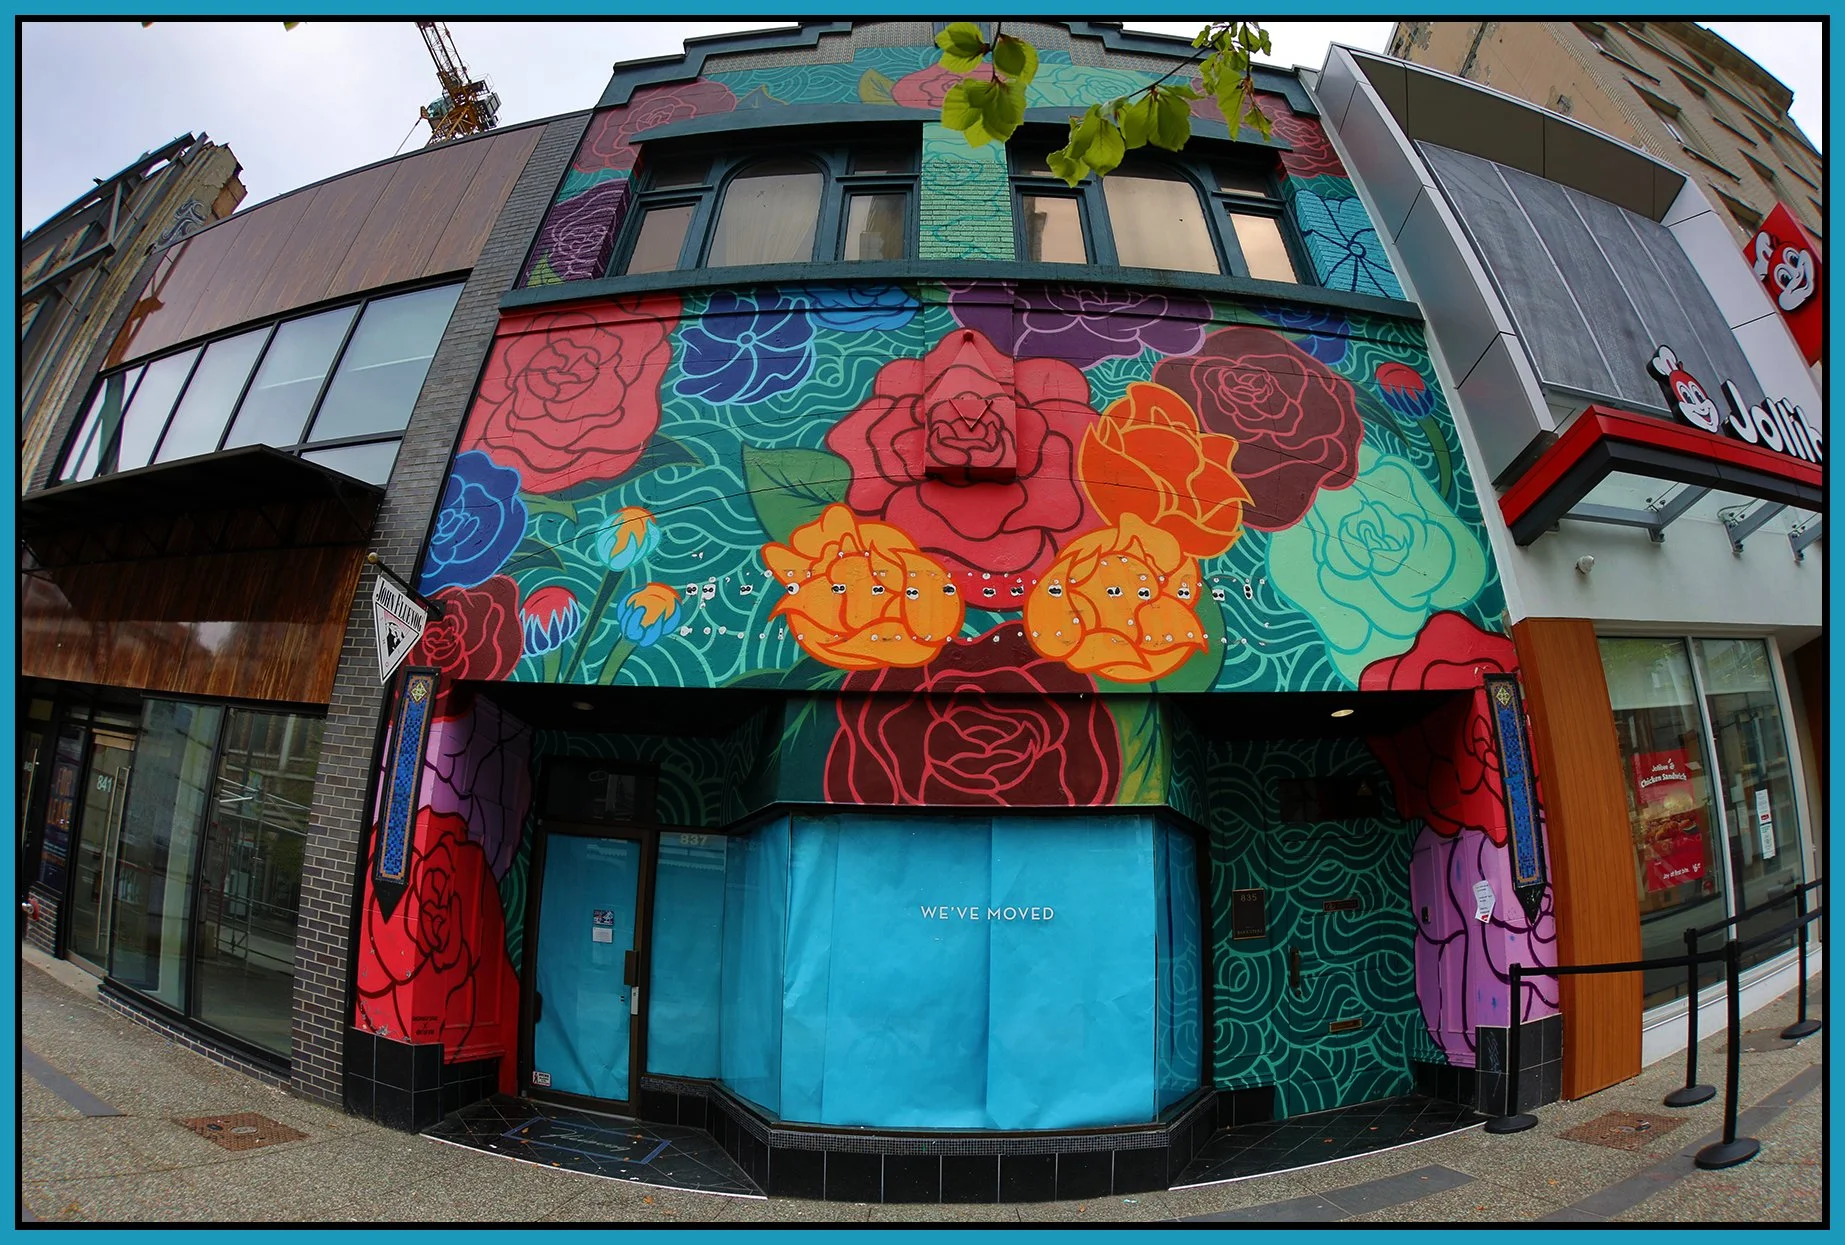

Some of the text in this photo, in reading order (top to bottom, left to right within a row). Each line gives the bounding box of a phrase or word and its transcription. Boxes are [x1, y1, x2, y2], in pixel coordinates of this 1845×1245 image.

[376, 580, 396, 612] JOHN
[97, 775, 112, 792] 841
[1640, 772, 1687, 788] Chicken Sandwich
[680, 834, 708, 846] 837
[1240, 893, 1258, 902] 835
[921, 906, 1055, 920] WE'VE MOVED
